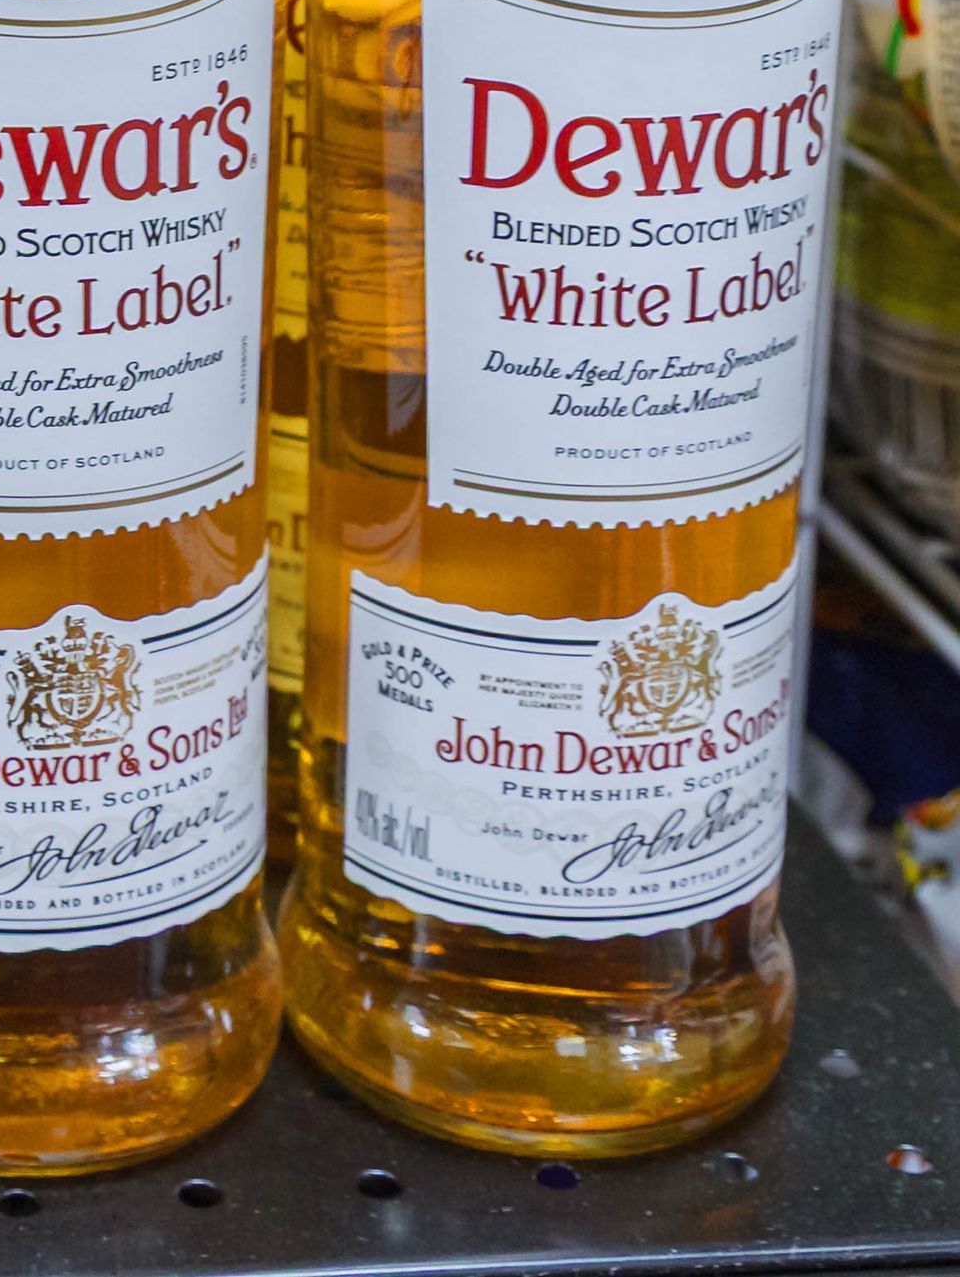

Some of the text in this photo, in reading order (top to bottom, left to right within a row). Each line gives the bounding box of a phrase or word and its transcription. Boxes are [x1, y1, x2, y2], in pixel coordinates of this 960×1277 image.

[208, 44, 248, 70] 1846
[460, 68, 828, 198] Dewar's
[16, 227, 134, 258] SCOTCH
[141, 208, 227, 247] WHISKY
[492, 194, 809, 249] BLENDED SCOTCH WHISKY
[17, 367, 53, 396] for
[54, 368, 116, 391] Extra
[117, 347, 224, 391] Smoothness
[483, 350, 561, 380] Double
[565, 358, 623, 388] Aged
[623, 358, 659, 387] for
[660, 355, 715, 380] Extra
[26, 402, 80, 428] Cask
[82, 393, 174, 426] Matured
[549, 378, 762, 417] Double Cask Matured
[46, 457, 68, 470] OF
[75, 446, 165, 468] SCOTLAND
[554, 430, 753, 460] PRODUCT OF SCOTLAND
[361, 641, 392, 660] GOLD
[411, 647, 456, 690] PRIZE
[385, 660, 424, 689] 500
[378, 679, 434, 713] MEDALS
[118, 744, 140, 776] &
[147, 718, 223, 771] Sons
[436, 716, 545, 773] John
[554, 731, 693, 775] Dewar
[698, 729, 718, 762] &
[103, 767, 213, 807] SCOTLAND
[502, 749, 769, 801] PERTHSHIRE, SCOTLAND
[481, 822, 588, 843] John Dewar
[48, 898, 81, 909] AND
[93, 882, 163, 905] BOTTLED
[540, 885, 617, 897] BLENDED
[629, 884, 660, 895] AND
